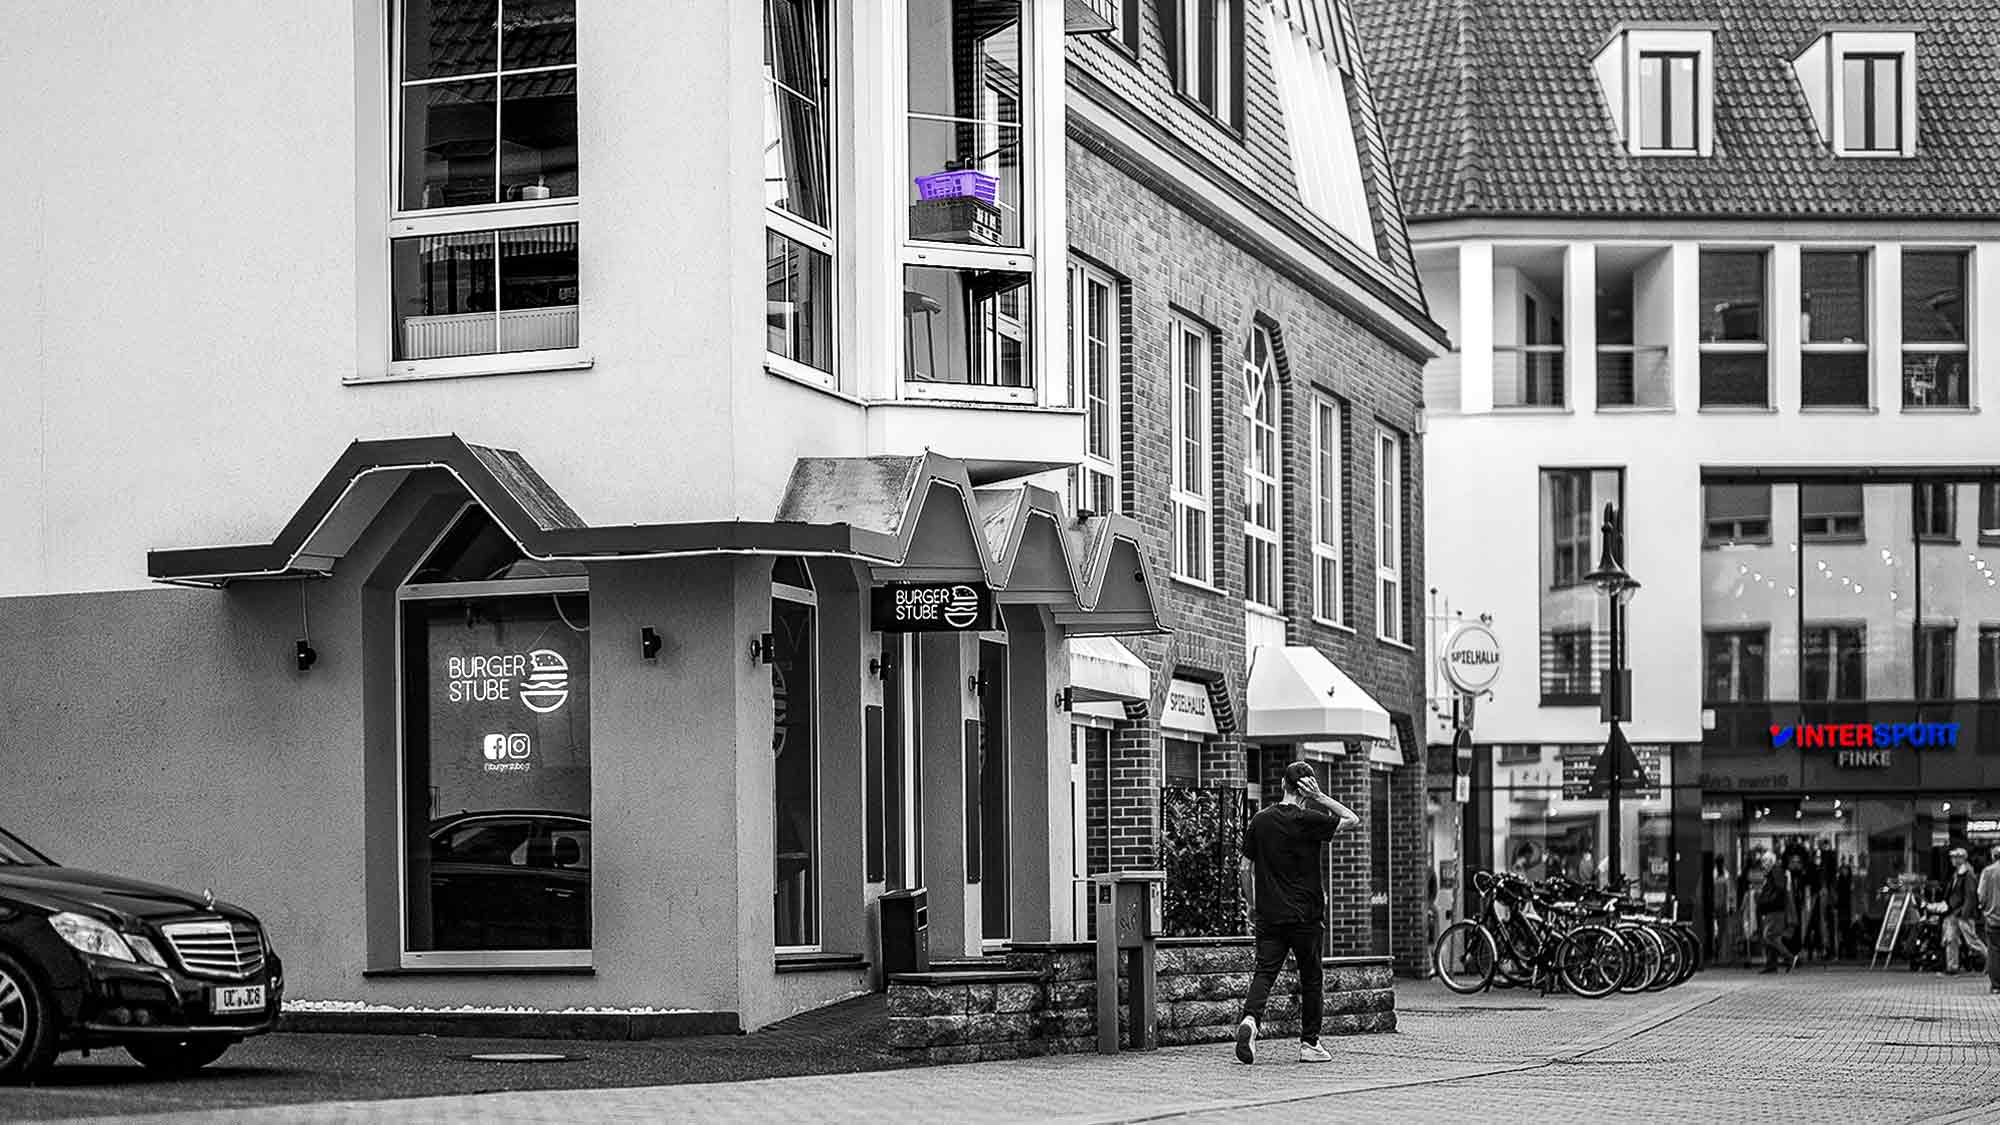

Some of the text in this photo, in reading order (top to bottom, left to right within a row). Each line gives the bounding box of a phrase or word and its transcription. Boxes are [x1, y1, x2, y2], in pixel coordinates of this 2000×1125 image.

[896, 588, 950, 605] BURGER
[896, 604, 938, 621] STUBE
[448, 654, 527, 679] BURGER
[1450, 649, 1500, 665] SPIELHALLE
[449, 678, 512, 703] STUBE
[1170, 691, 1206, 717] SPIELHALLE
[1796, 722, 1961, 748] INTERSPORT
[1838, 750, 1892, 768] FINKE
